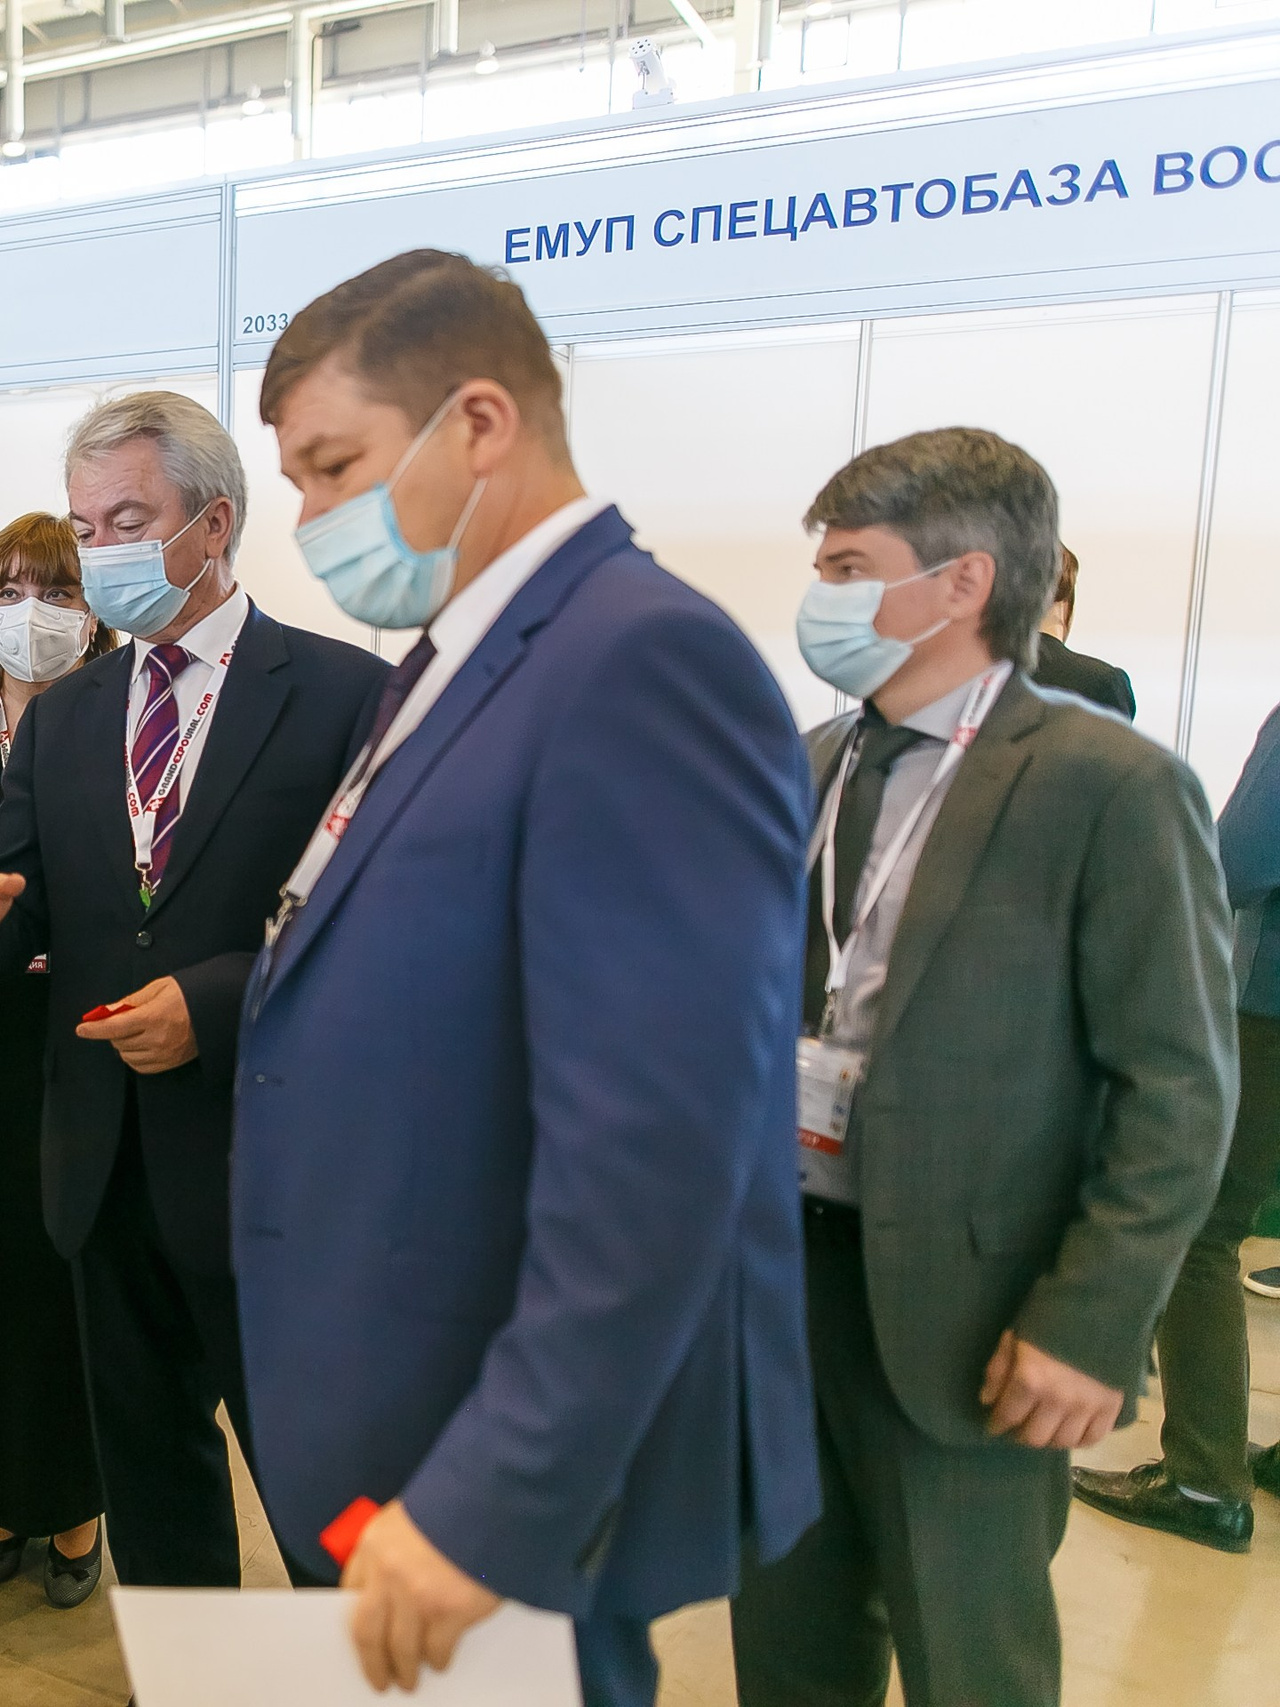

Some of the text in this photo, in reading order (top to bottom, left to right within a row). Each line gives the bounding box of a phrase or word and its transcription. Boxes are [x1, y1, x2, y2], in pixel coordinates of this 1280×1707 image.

[505, 214, 635, 264] ЕМУП
[653, 159, 1130, 247] СПЕЦАВТОБАЗА
[243, 312, 289, 335] 2033
